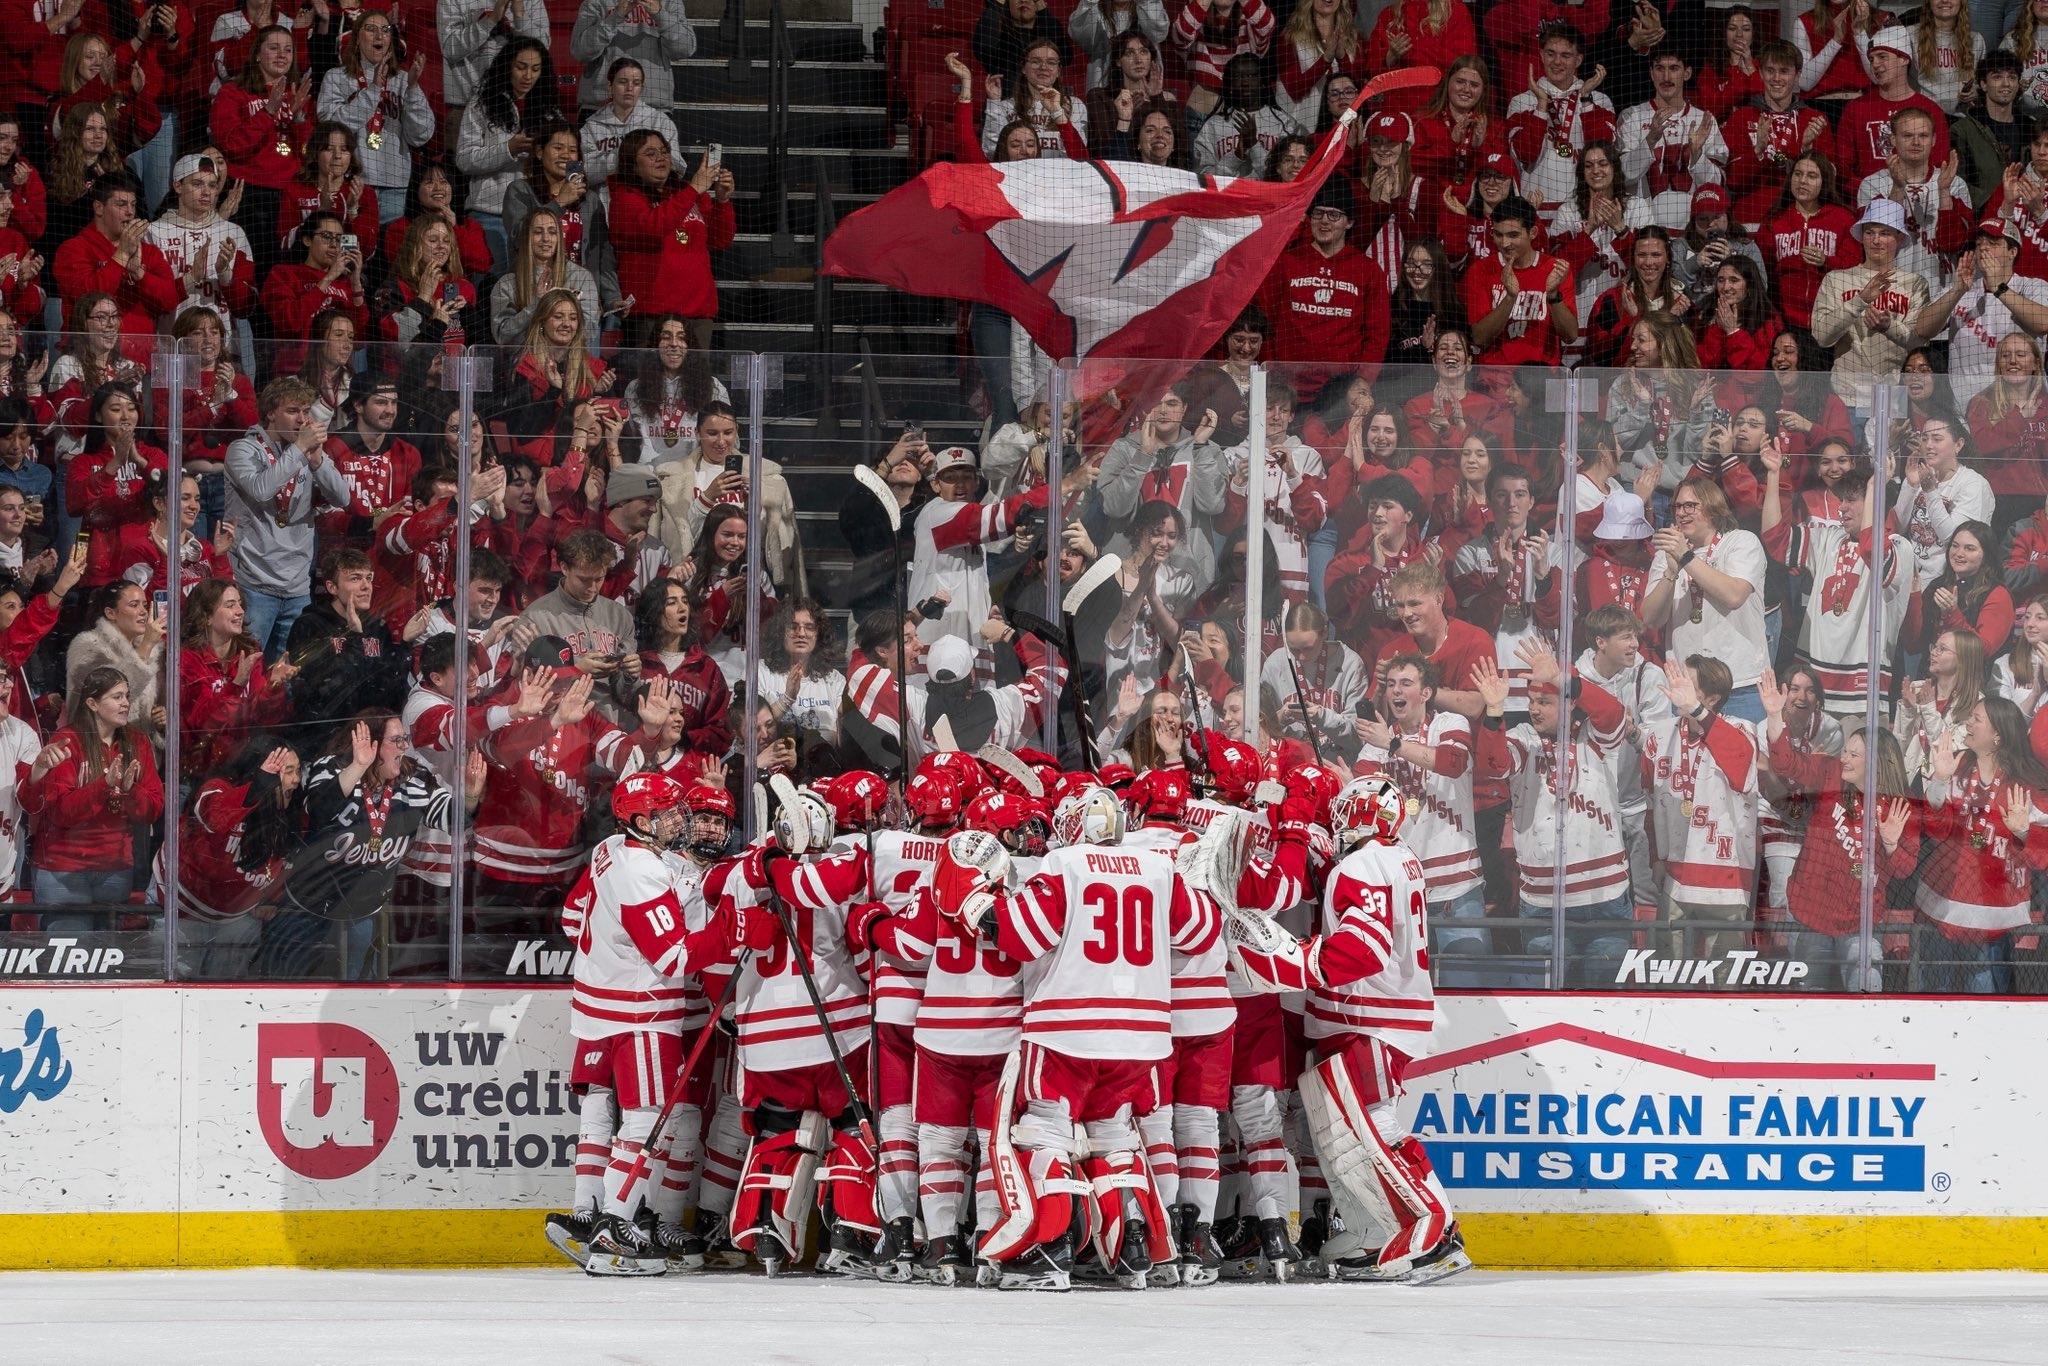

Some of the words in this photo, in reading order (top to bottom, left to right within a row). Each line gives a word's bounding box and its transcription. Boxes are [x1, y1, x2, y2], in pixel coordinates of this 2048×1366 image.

[1290, 276, 1359, 297] WISCONSIN
[1291, 301, 1353, 318] BADGERS
[941, 797, 953, 810] 22
[1086, 854, 1142, 876] PULVER
[1360, 888, 1387, 918] 33
[645, 904, 676, 938] 18
[1082, 882, 1154, 967] 30
[48, 937, 124, 974] TRIP
[1723, 950, 1809, 986] TRIP
[415, 1032, 504, 1066] uw
[1411, 1093, 1702, 1136] AMERICAN
[1729, 1096, 1926, 1138] FAMILY
[999, 1154, 1021, 1212] CCM
[1452, 1152, 1885, 1183] INSURANCE
